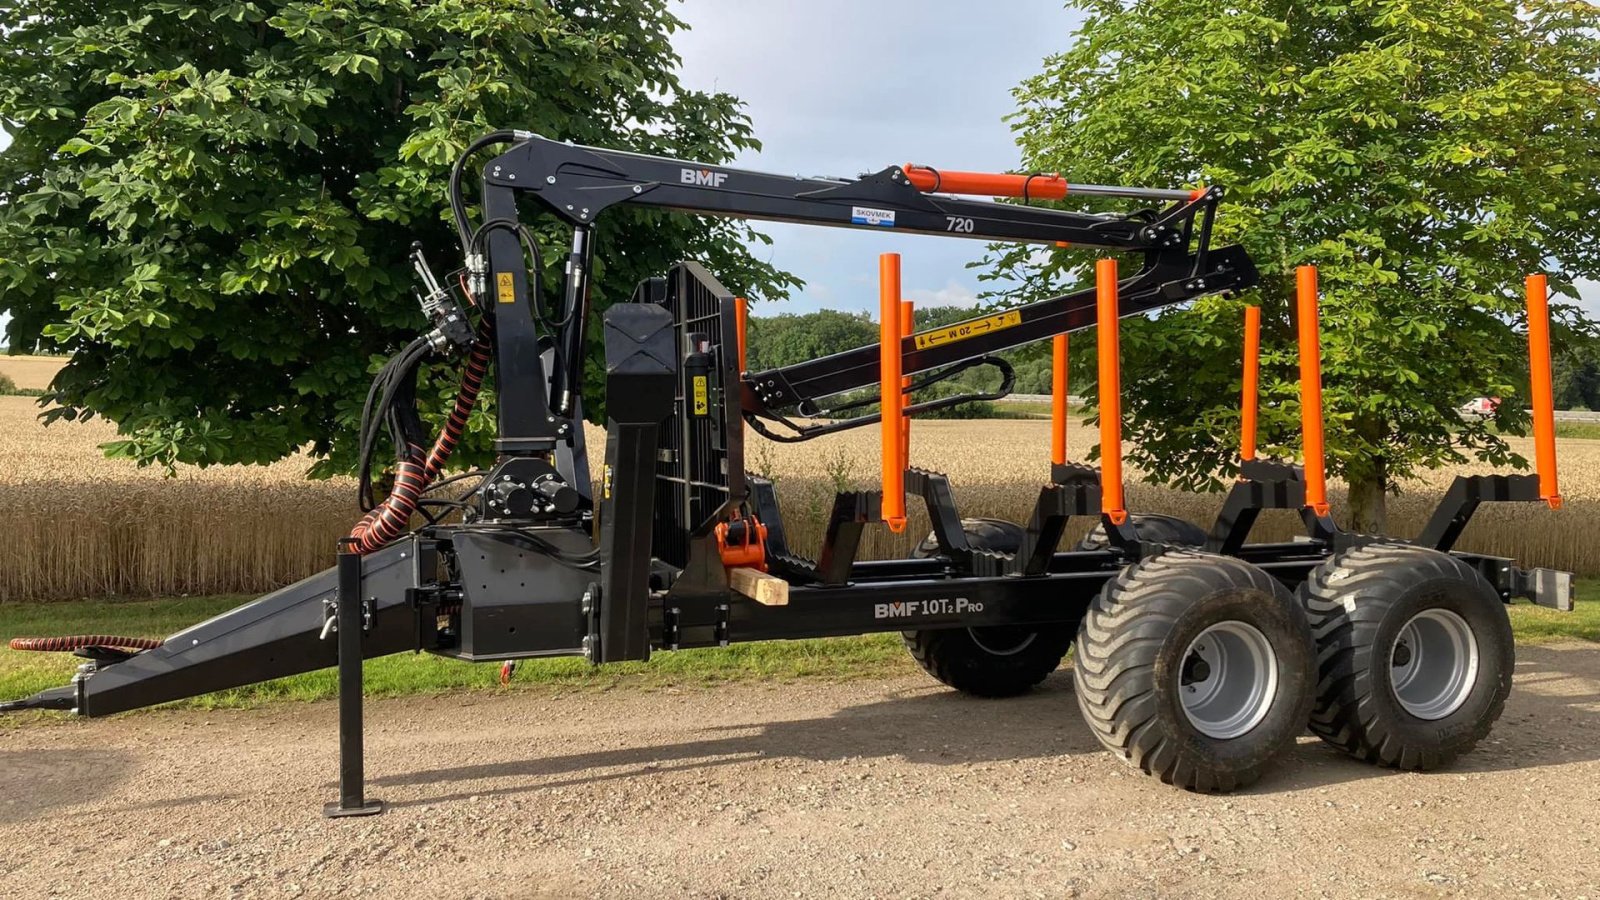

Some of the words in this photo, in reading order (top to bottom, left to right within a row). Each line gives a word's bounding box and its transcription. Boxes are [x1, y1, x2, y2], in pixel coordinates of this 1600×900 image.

[680, 168, 729, 187] BMF
[856, 209, 892, 219] SKOVMEK
[946, 216, 974, 233] 720
[948, 331, 957, 339] M
[959, 326, 971, 336] 20
[874, 601, 920, 619] BMF
